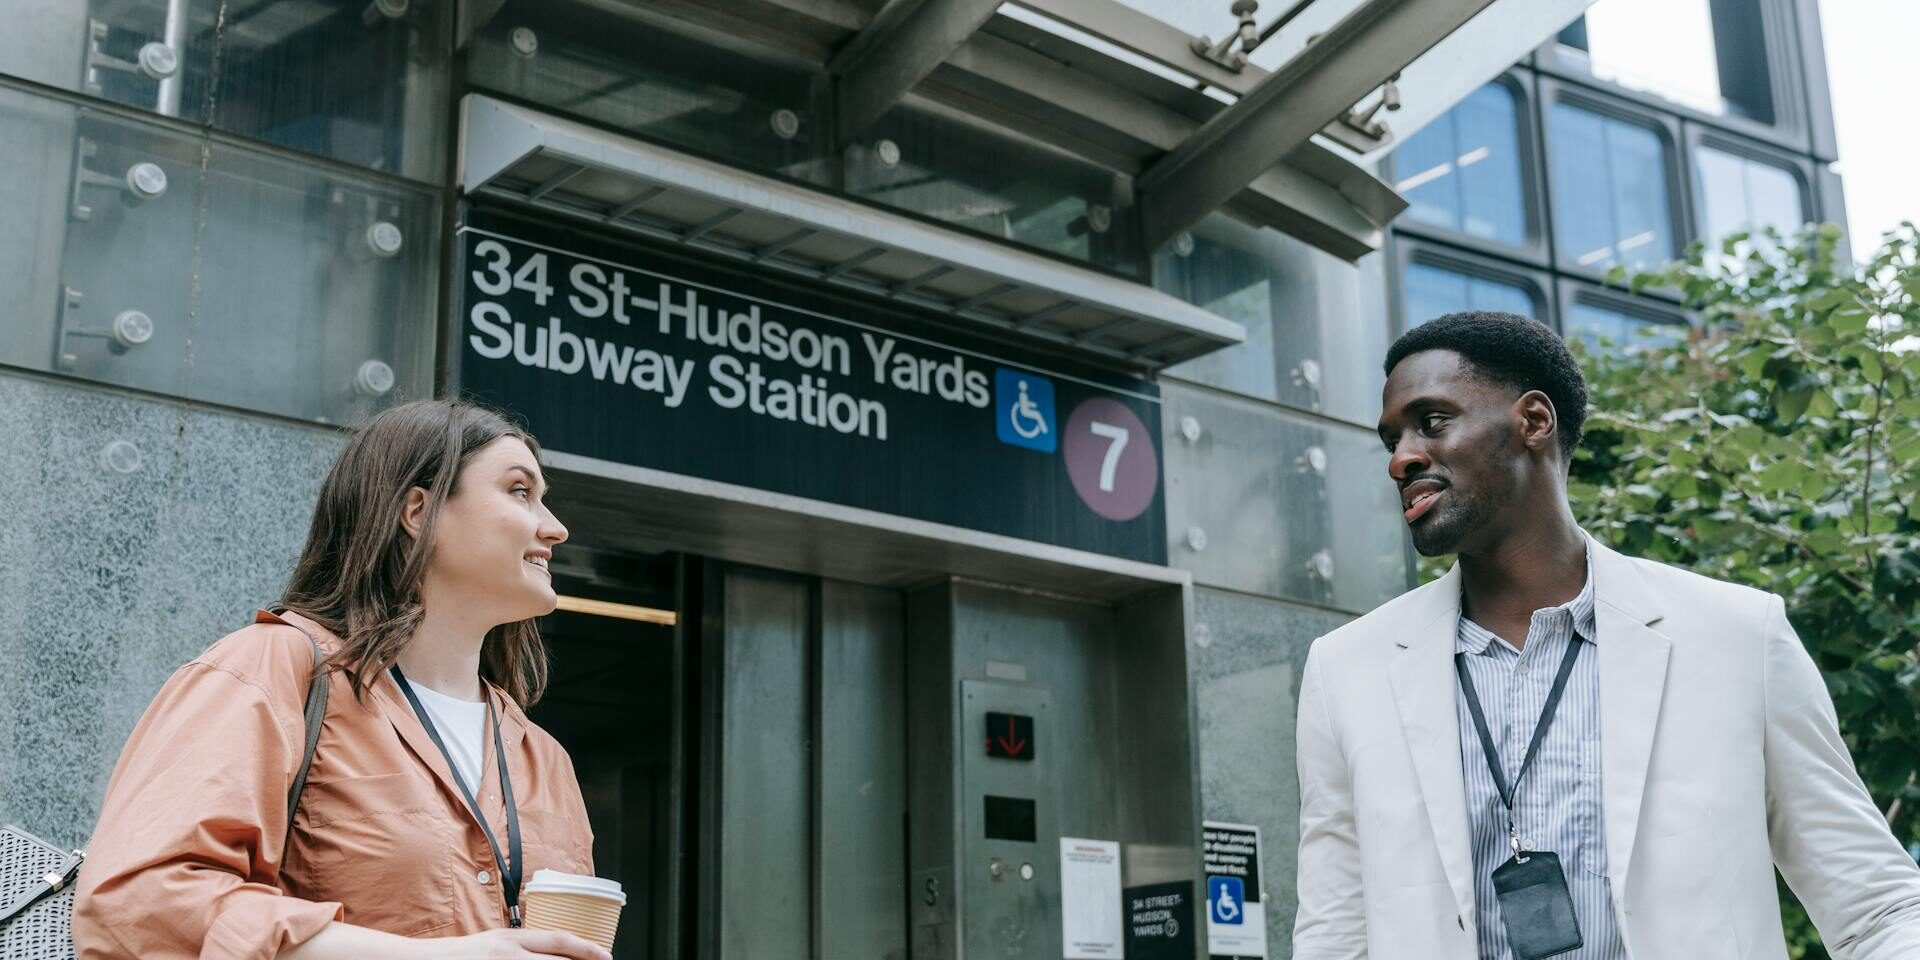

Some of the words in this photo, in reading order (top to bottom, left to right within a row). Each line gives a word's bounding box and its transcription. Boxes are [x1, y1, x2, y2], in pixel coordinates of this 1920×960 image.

[469, 301, 695, 408] Subway
[708, 354, 888, 440] Station
[472, 240, 554, 306] 34
[862, 333, 990, 408] Yards
[1091, 421, 1129, 492] 7
